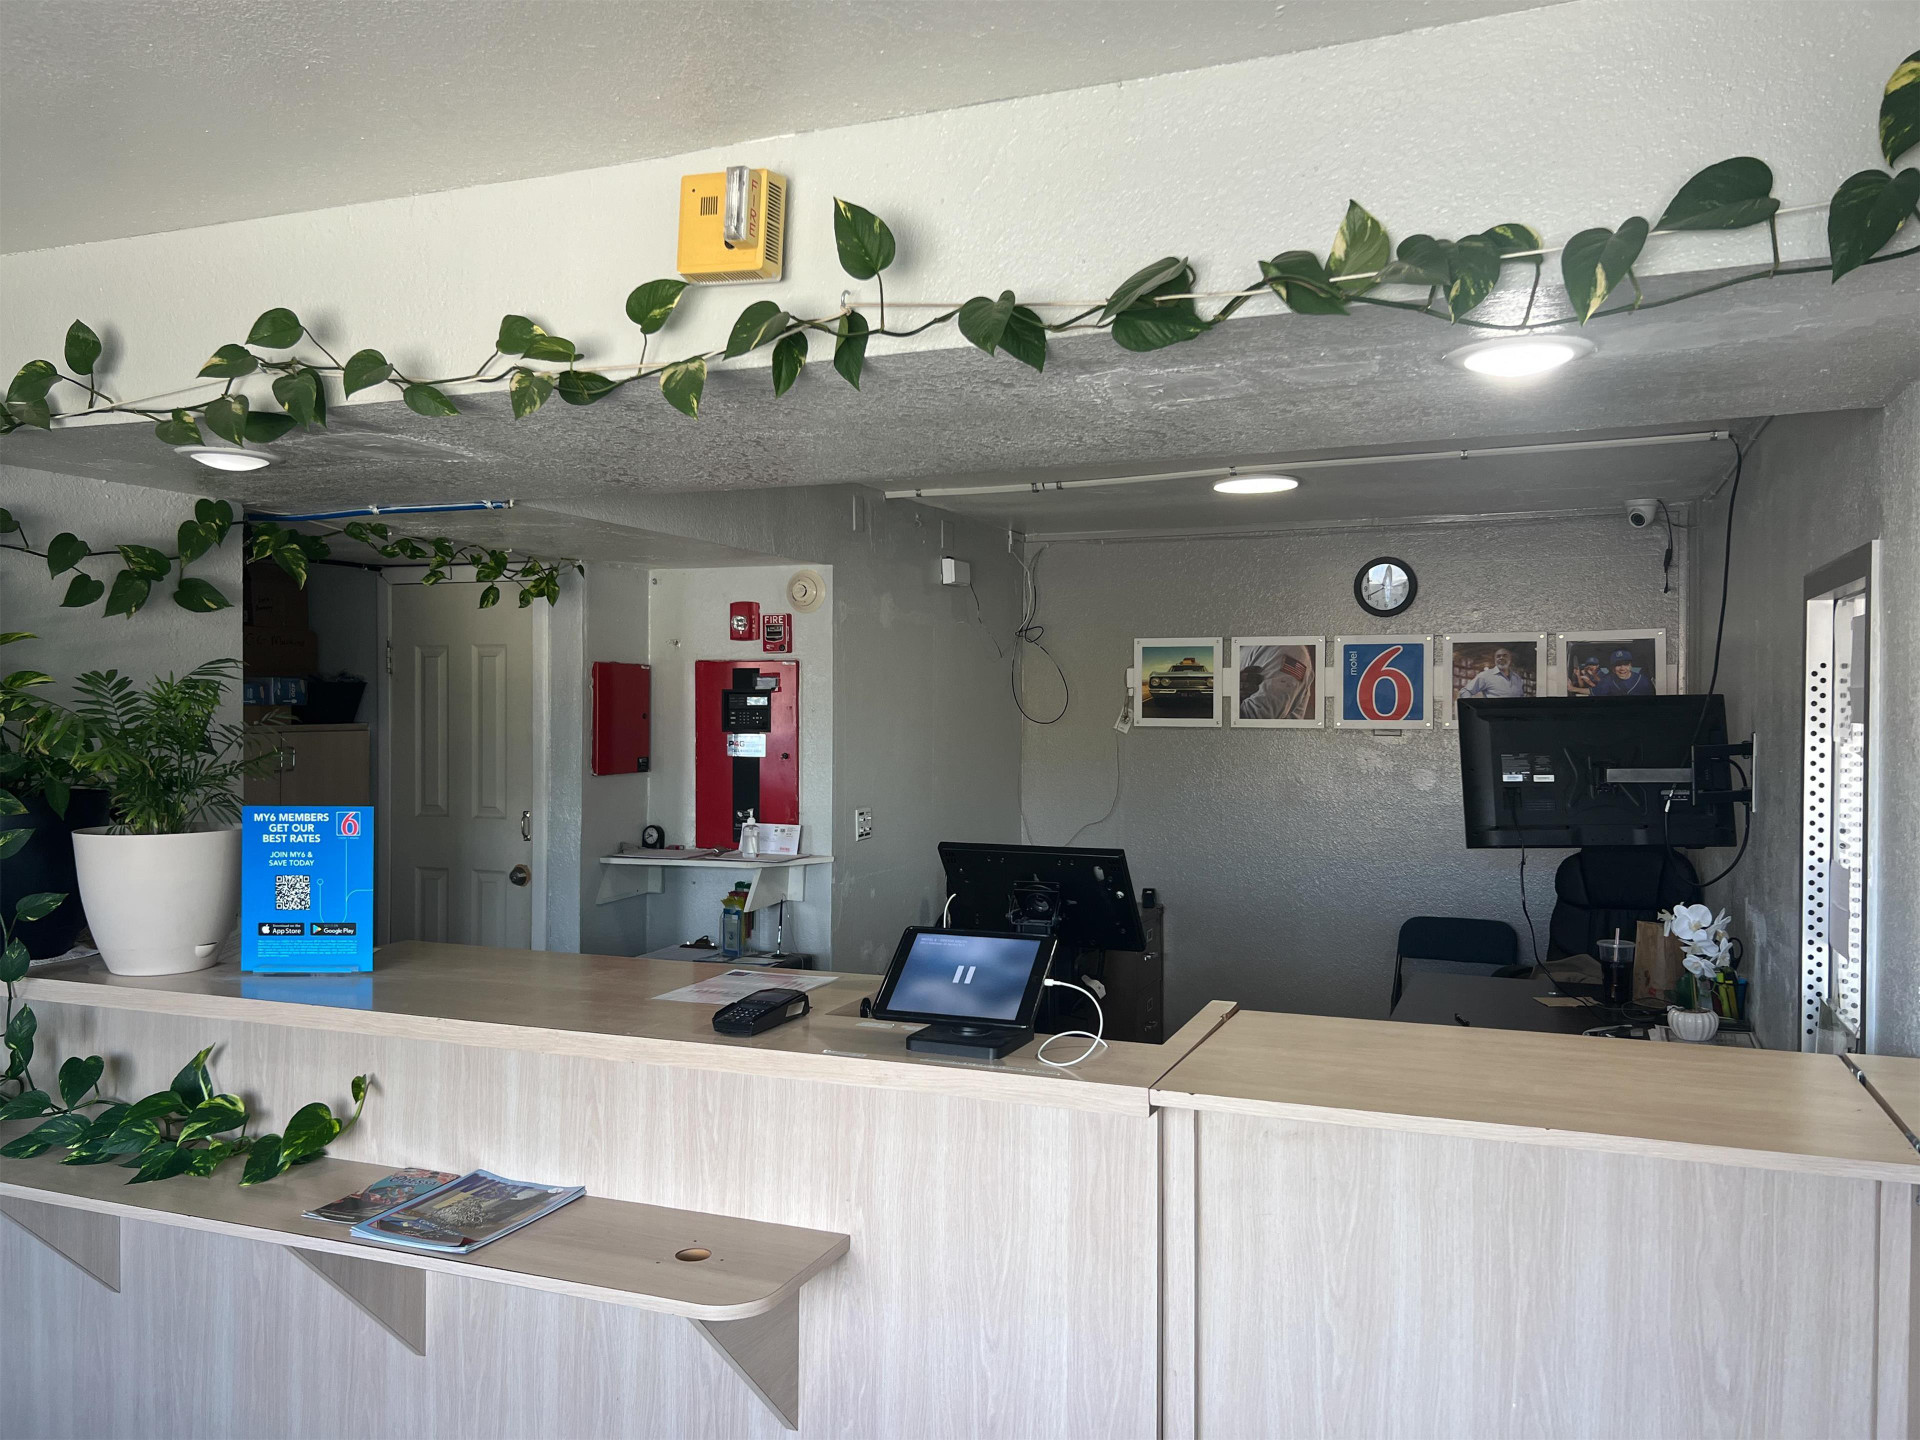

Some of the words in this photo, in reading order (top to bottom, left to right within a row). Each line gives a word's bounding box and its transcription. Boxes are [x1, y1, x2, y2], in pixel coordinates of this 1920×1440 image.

[749, 179, 758, 238] FIRE
[764, 615, 784, 624] FIRE
[1349, 651, 1358, 676] motel
[1356, 645, 1414, 720] 6
[253, 813, 276, 822] MY6
[279, 813, 330, 822] MEMBERS
[268, 823, 289, 833] GET
[291, 823, 315, 833] OUR
[341, 812, 359, 836] 6
[262, 834, 287, 843] BEST
[289, 834, 321, 843] RATES
[268, 859, 287, 867] SAVE
[289, 859, 315, 867] TODAY
